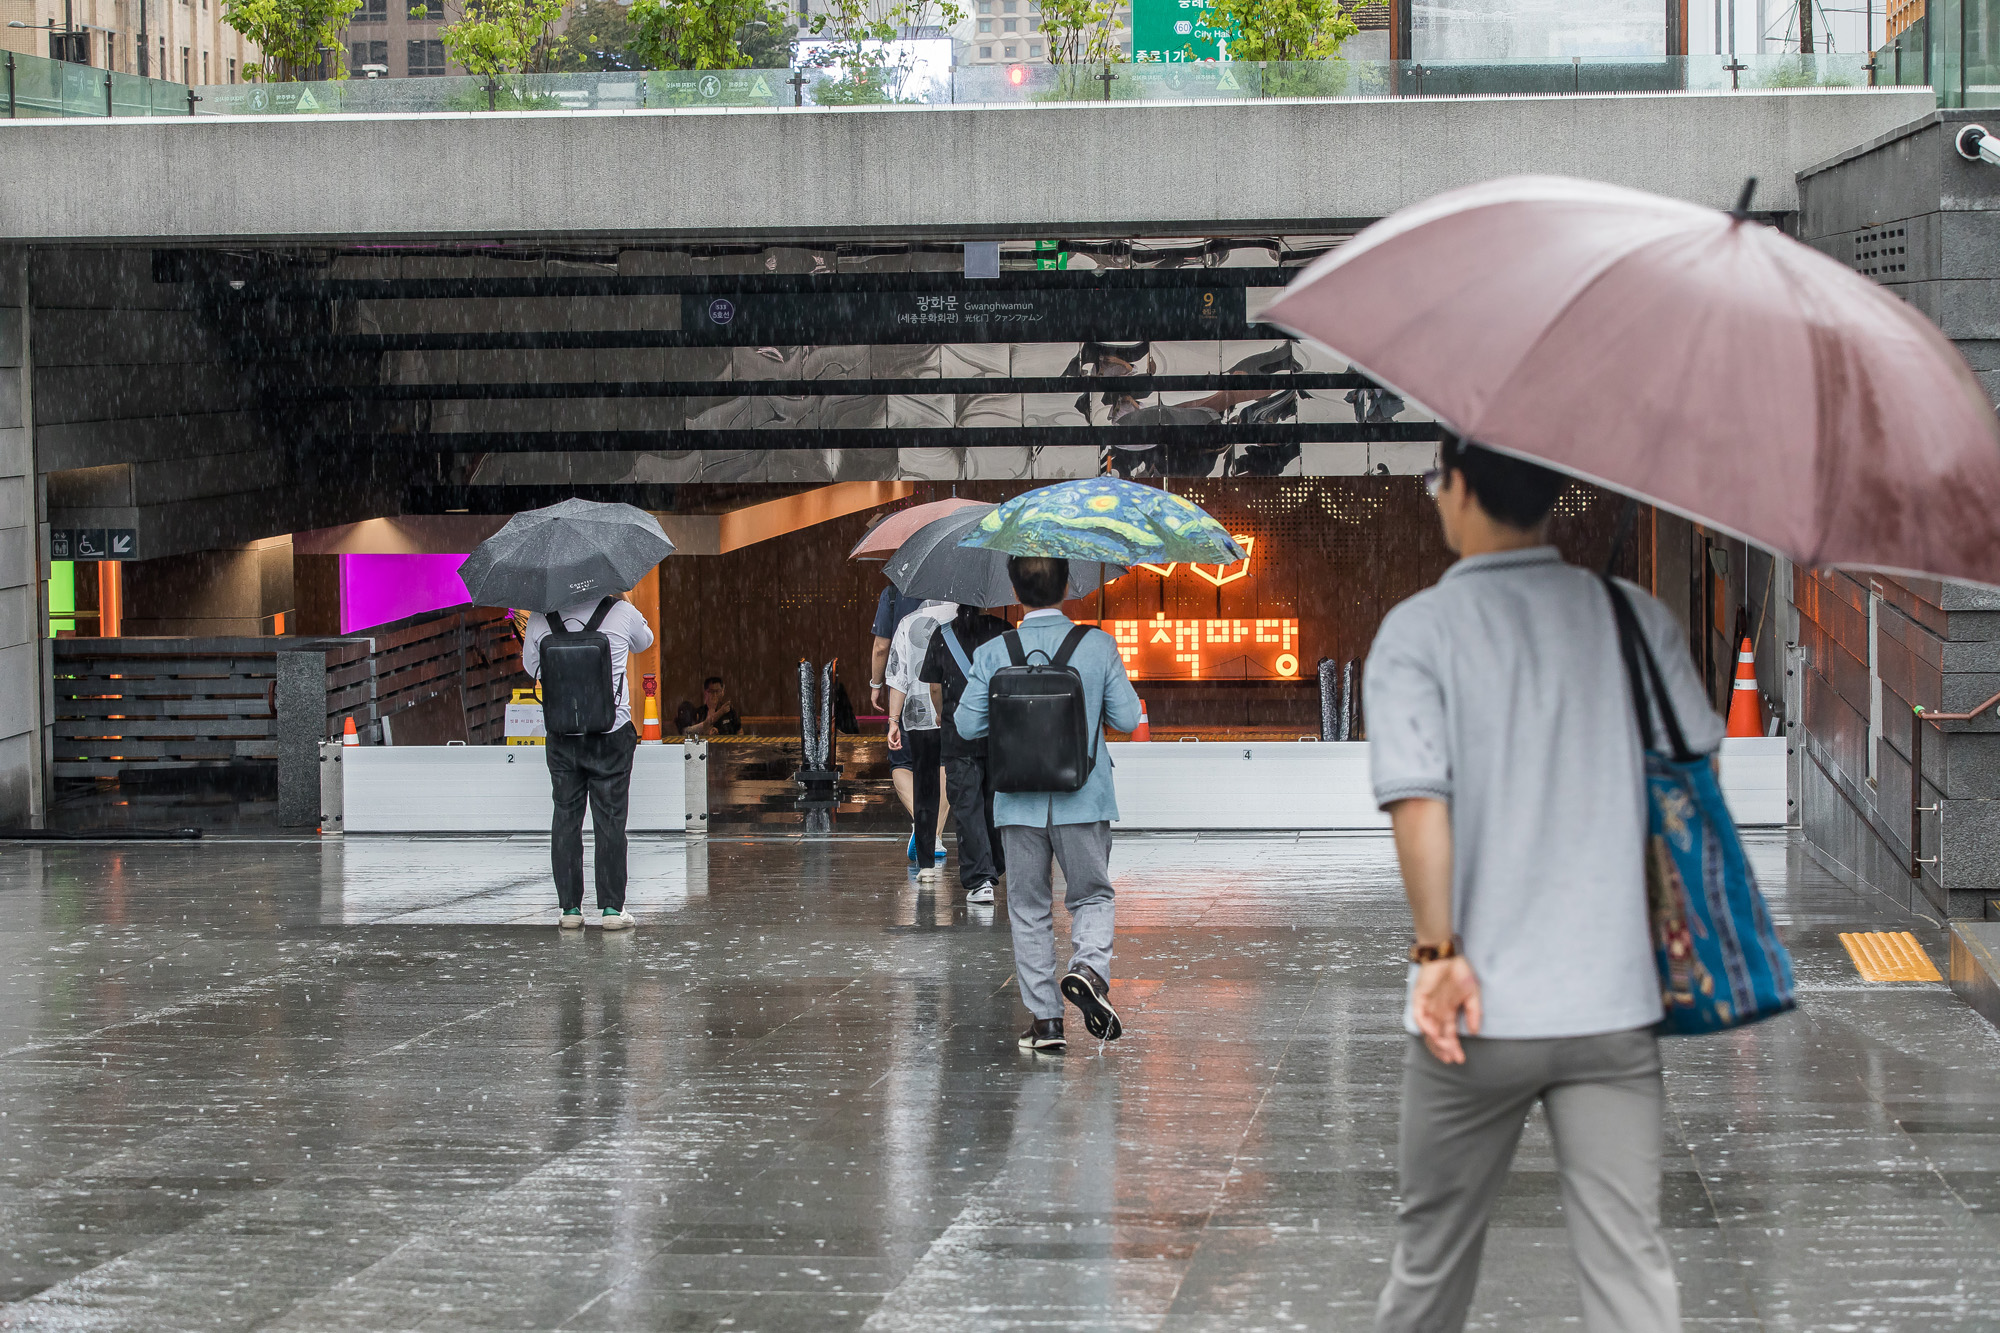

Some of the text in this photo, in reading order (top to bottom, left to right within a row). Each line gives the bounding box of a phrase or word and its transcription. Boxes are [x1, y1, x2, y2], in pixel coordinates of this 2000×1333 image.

[1178, 23, 1189, 31] 60
[1194, 30, 1212, 39] City
[1136, 50, 1186, 63] 종로1가
[916, 296, 959, 311] 광화문
[1203, 293, 1214, 307] 9
[964, 302, 1034, 312] Gwanghwamun
[712, 311, 730, 319] 5호선
[897, 313, 959, 324] (세종문화회관)
[507, 754, 514, 763] 2
[1244, 750, 1251, 760] 4
